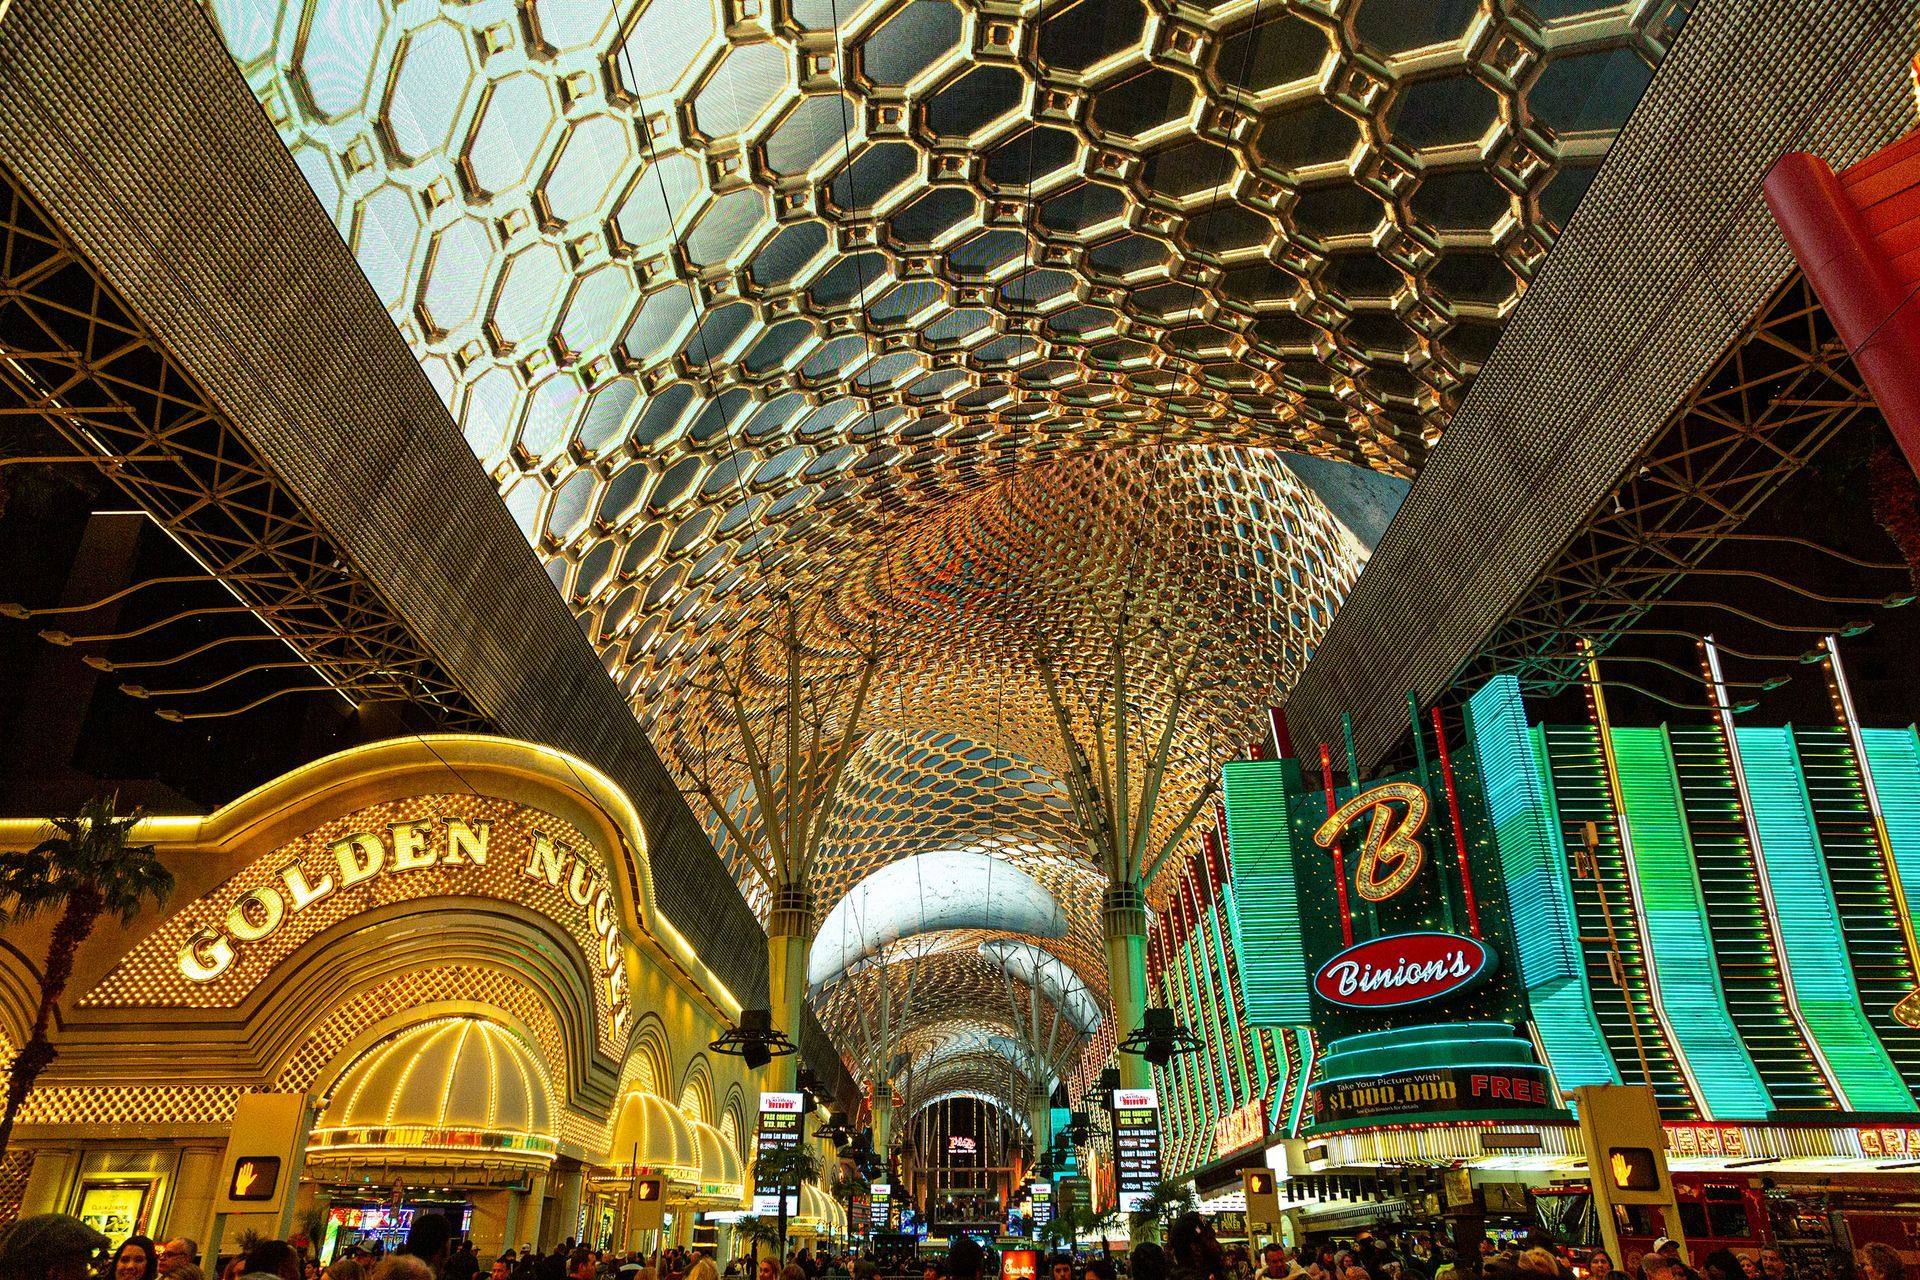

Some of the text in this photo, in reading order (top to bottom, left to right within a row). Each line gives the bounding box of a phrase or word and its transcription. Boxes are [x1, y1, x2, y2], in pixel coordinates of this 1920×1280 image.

[1314, 782, 1428, 902] B
[177, 816, 627, 1041] GOLDEN NUGGET
[1326, 950, 1471, 997] Binion's
[1329, 1080, 1456, 1111] $1,000,000
[1337, 1073, 1440, 1092] Take Your Picture With
[1471, 1075, 1546, 1105] FREE
